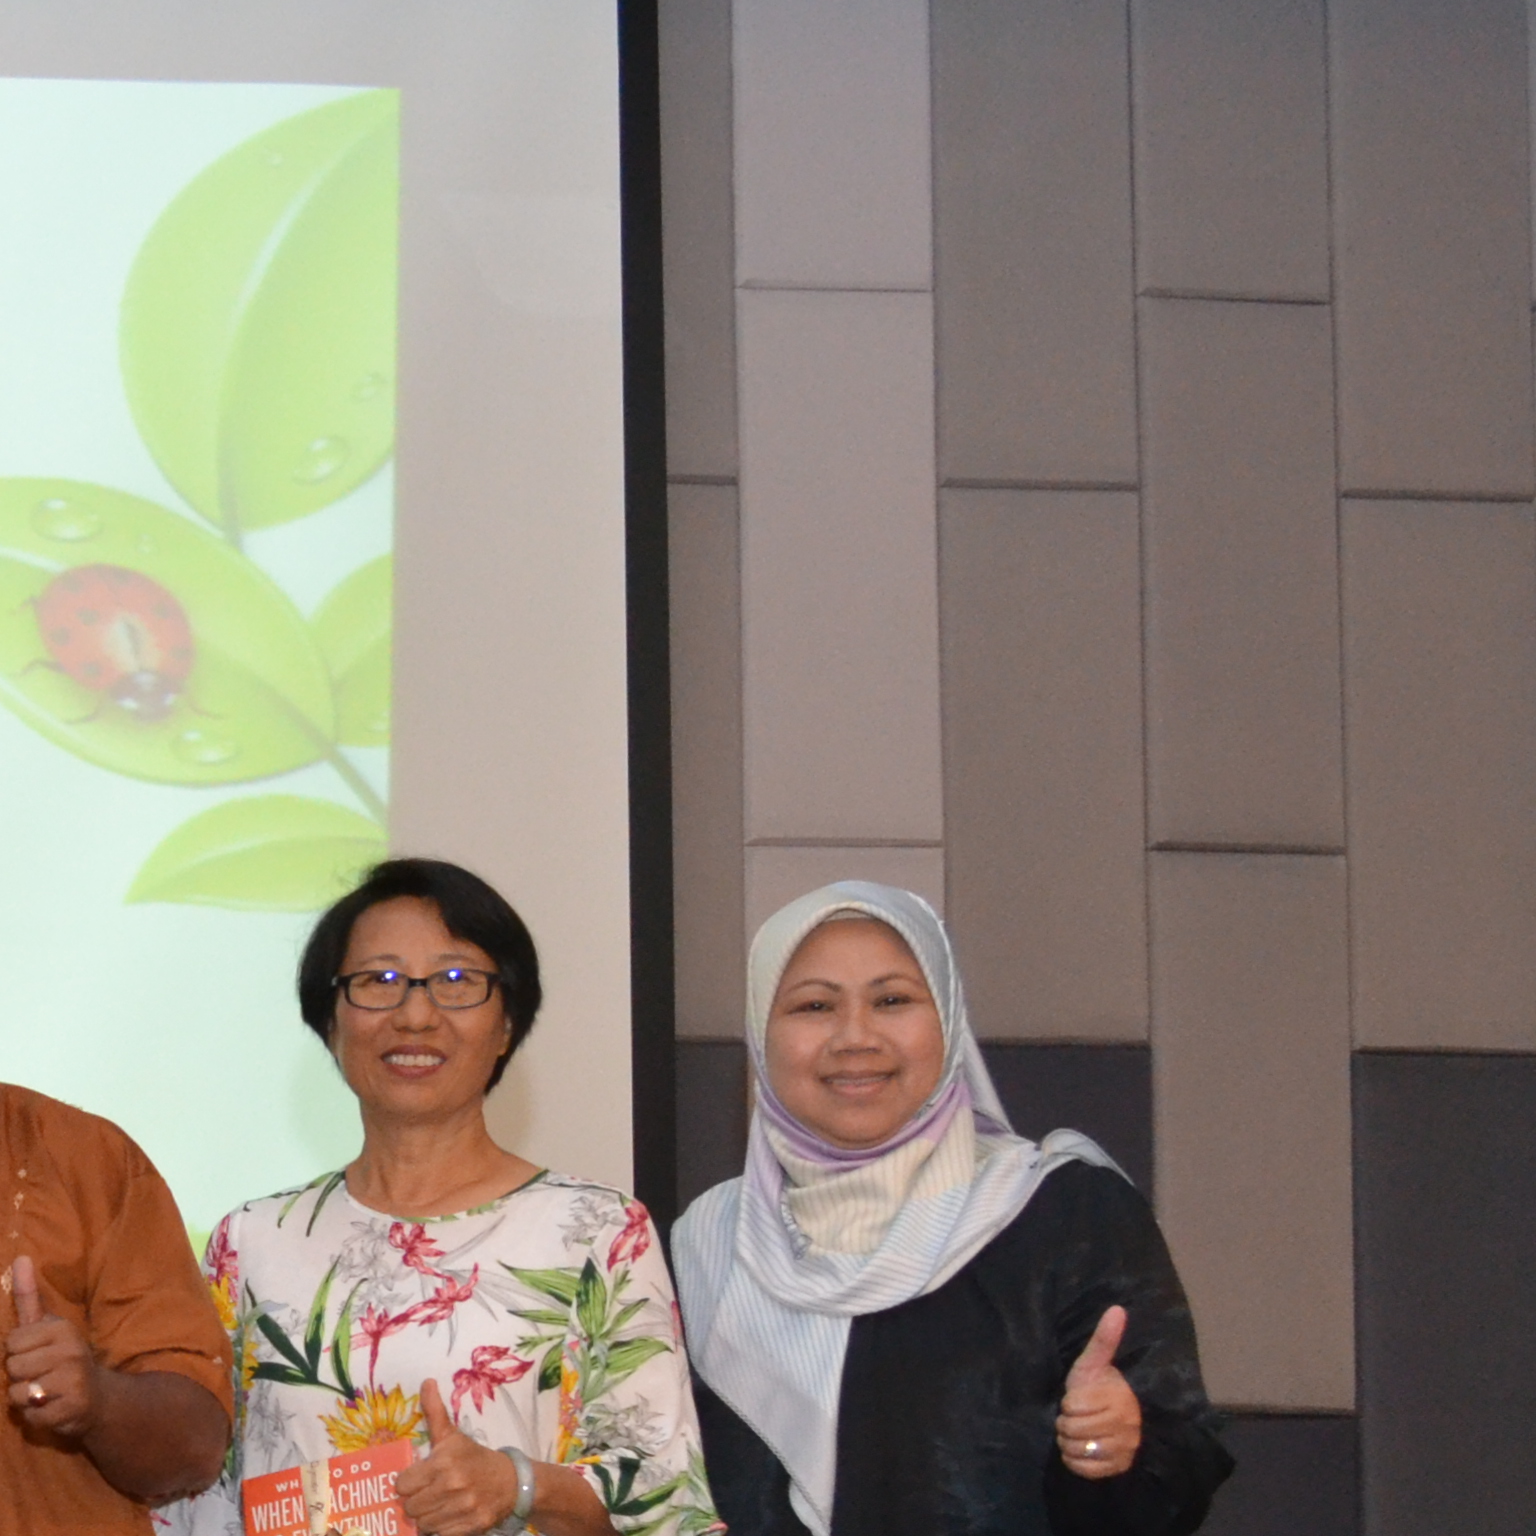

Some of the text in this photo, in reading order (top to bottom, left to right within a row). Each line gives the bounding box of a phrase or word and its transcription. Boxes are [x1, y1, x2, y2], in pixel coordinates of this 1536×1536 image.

[349, 1460, 372, 1475] DO
[251, 1494, 305, 1535] WHEN
[328, 1471, 401, 1515] ACHINES
